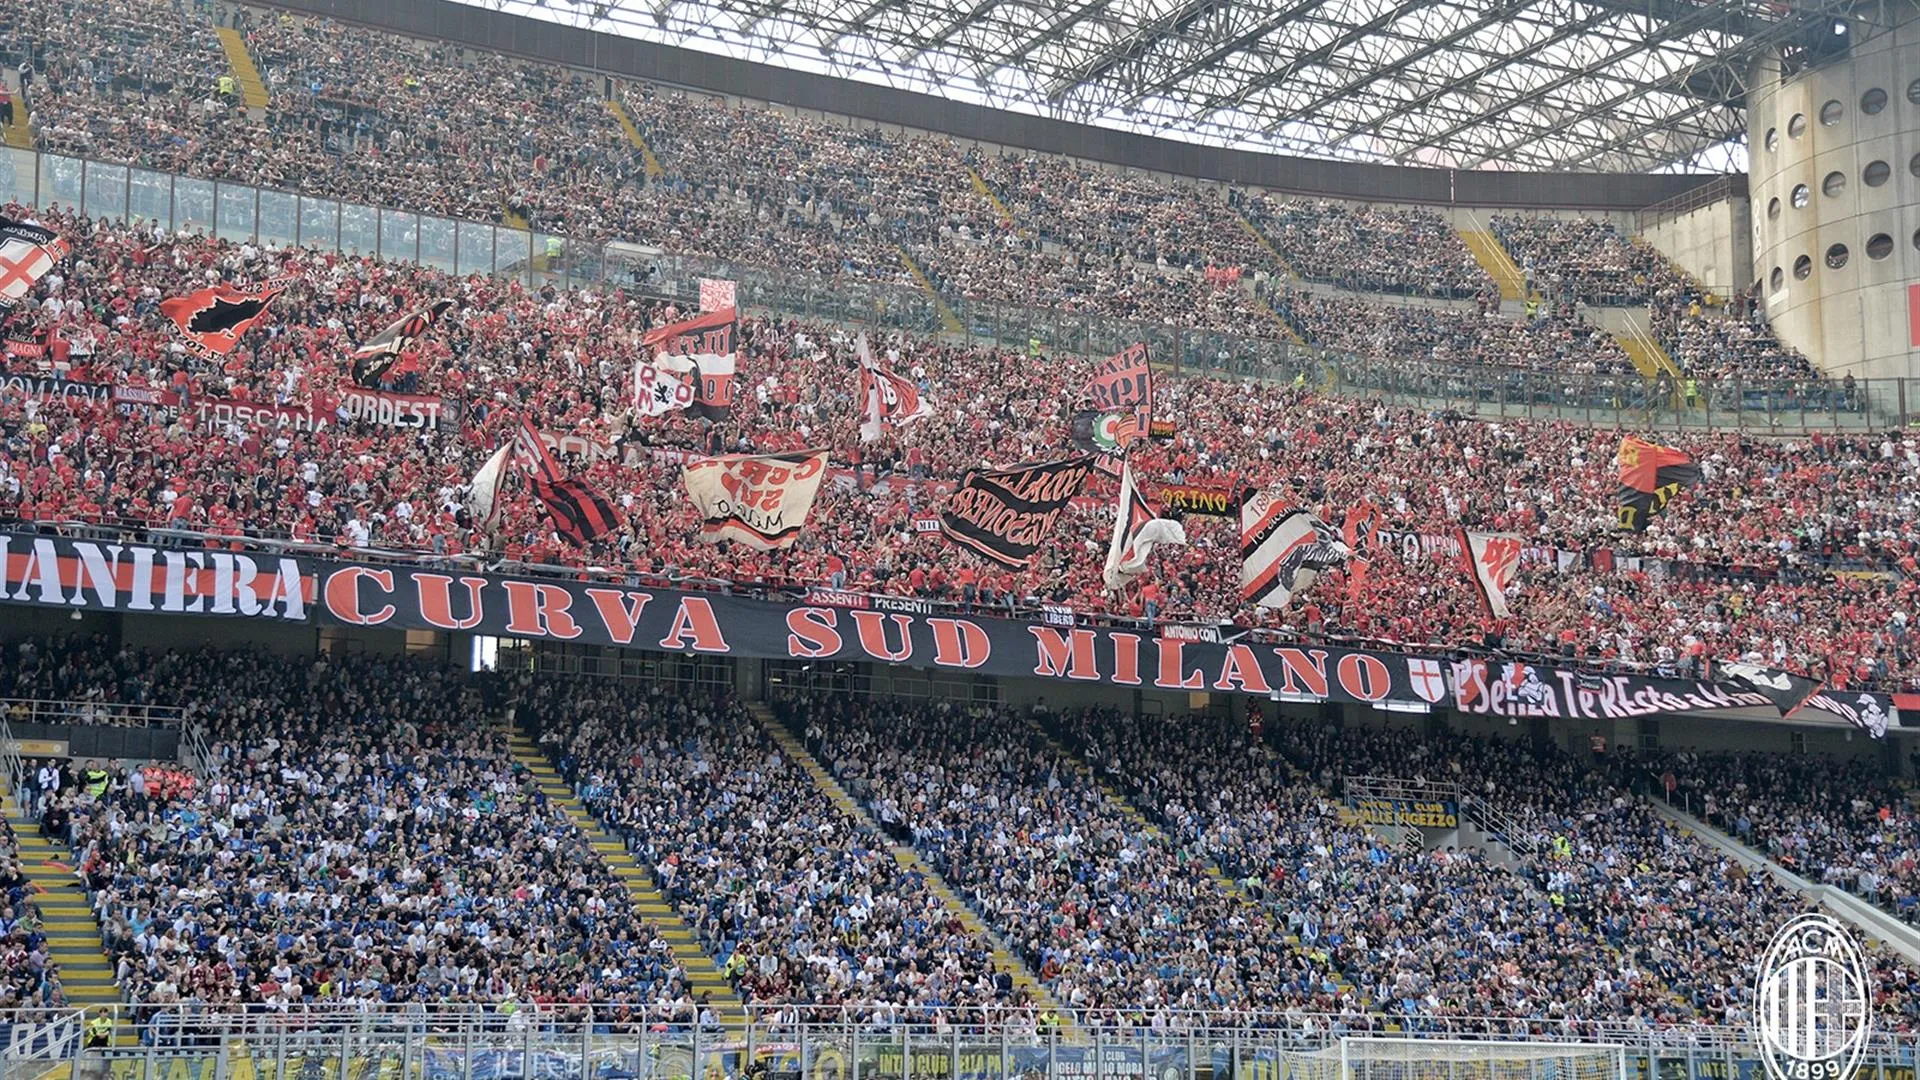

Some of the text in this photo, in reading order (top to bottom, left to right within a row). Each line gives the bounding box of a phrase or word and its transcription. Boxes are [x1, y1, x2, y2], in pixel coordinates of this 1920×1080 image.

[195, 401, 331, 433] TOSCANA
[340, 391, 440, 430] ORDEST
[1160, 487, 1228, 513] ORINO
[811, 592, 933, 614] ASSENTI PRESENTI
[1044, 612, 1075, 625] LIBERO
[324, 566, 1392, 702] CURVA SUD MILANO
[1164, 625, 1217, 643] ANTONIO CON
[1413, 803, 1444, 813] CLUB
[1397, 812, 1457, 828] VIGEZZO
[916, 1055, 949, 1074] CLUB
[951, 1055, 985, 1073] ELLA
